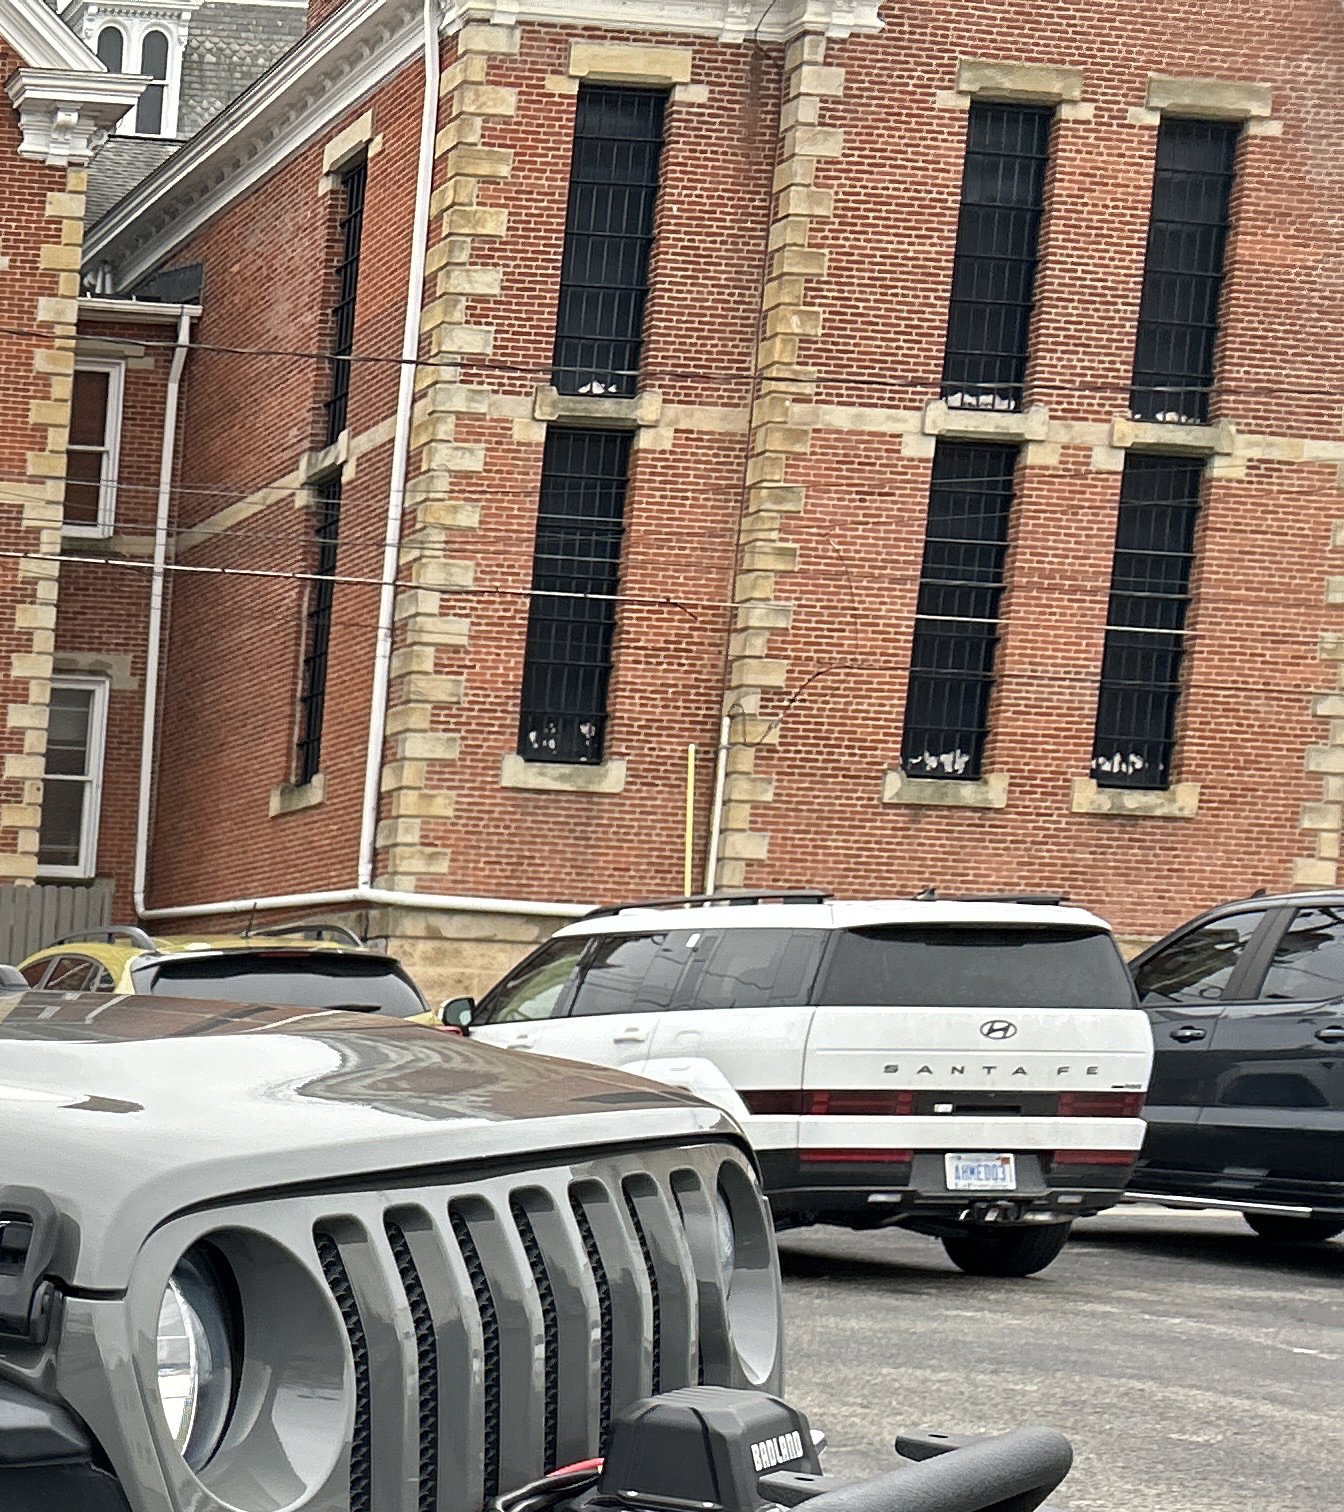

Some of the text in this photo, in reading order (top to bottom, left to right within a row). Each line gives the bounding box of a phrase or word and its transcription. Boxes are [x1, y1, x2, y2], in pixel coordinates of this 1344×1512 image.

[883, 1064, 1100, 1076] SANTA FE
[750, 1430, 804, 1472] BADLAND
